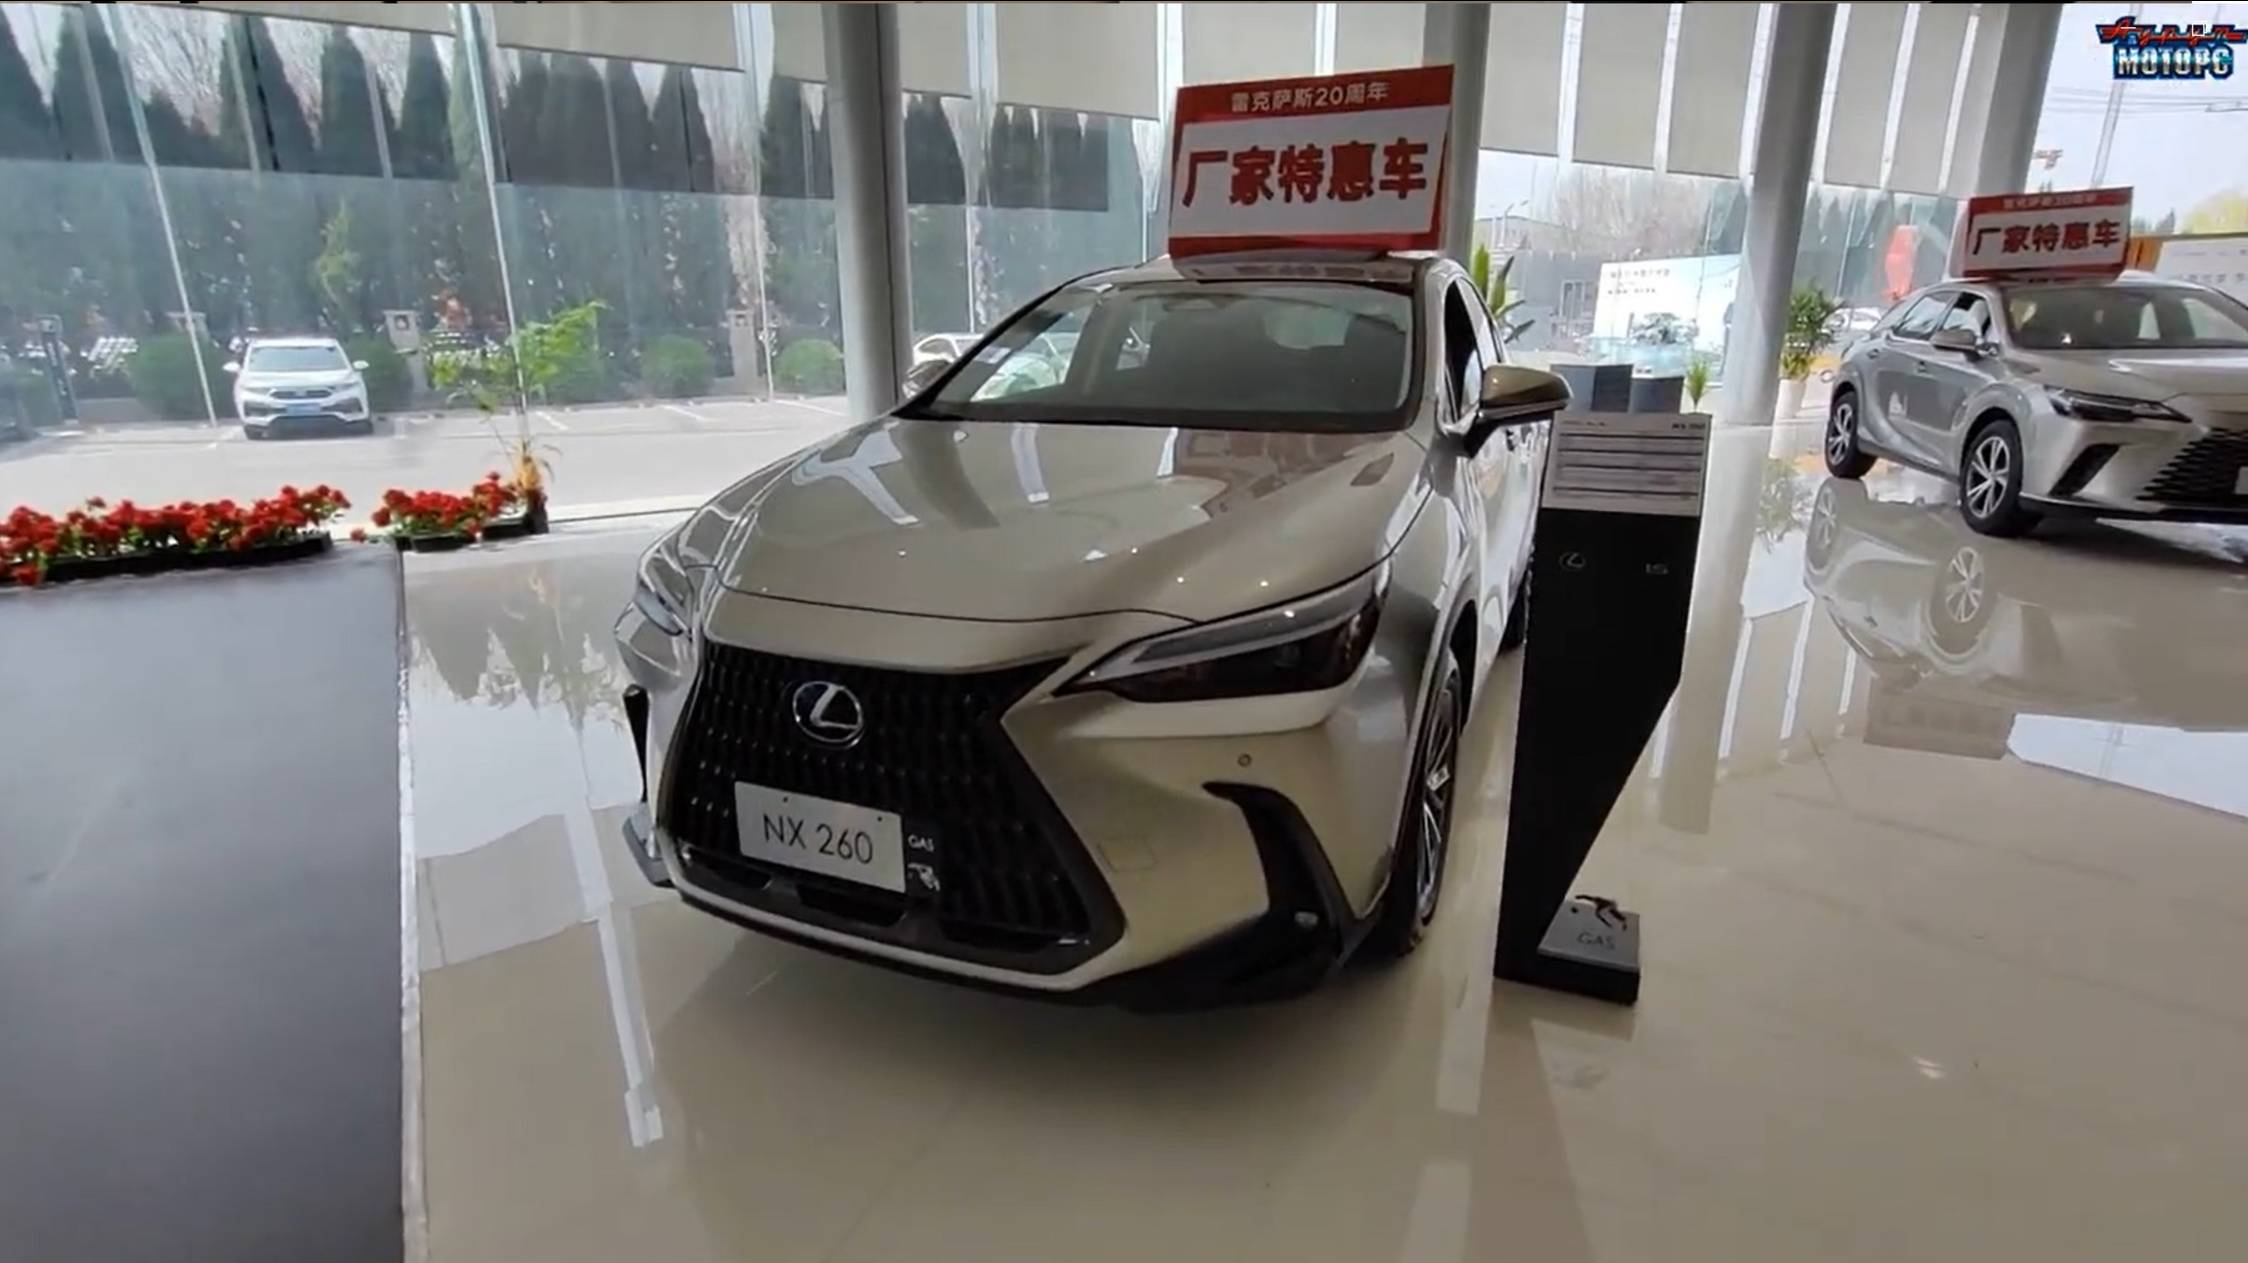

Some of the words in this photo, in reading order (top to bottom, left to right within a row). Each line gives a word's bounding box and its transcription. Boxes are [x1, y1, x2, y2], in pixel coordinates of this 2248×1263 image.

[1231, 81, 1391, 113] 雷克萨斯20周年
[1182, 136, 1429, 208] 厂家特惠车
[1972, 218, 2121, 255] 厂家特惠车
[762, 813, 807, 850] NX
[815, 822, 874, 865] 260
[907, 834, 935, 852] GAS
[1577, 930, 1616, 951] GAS
